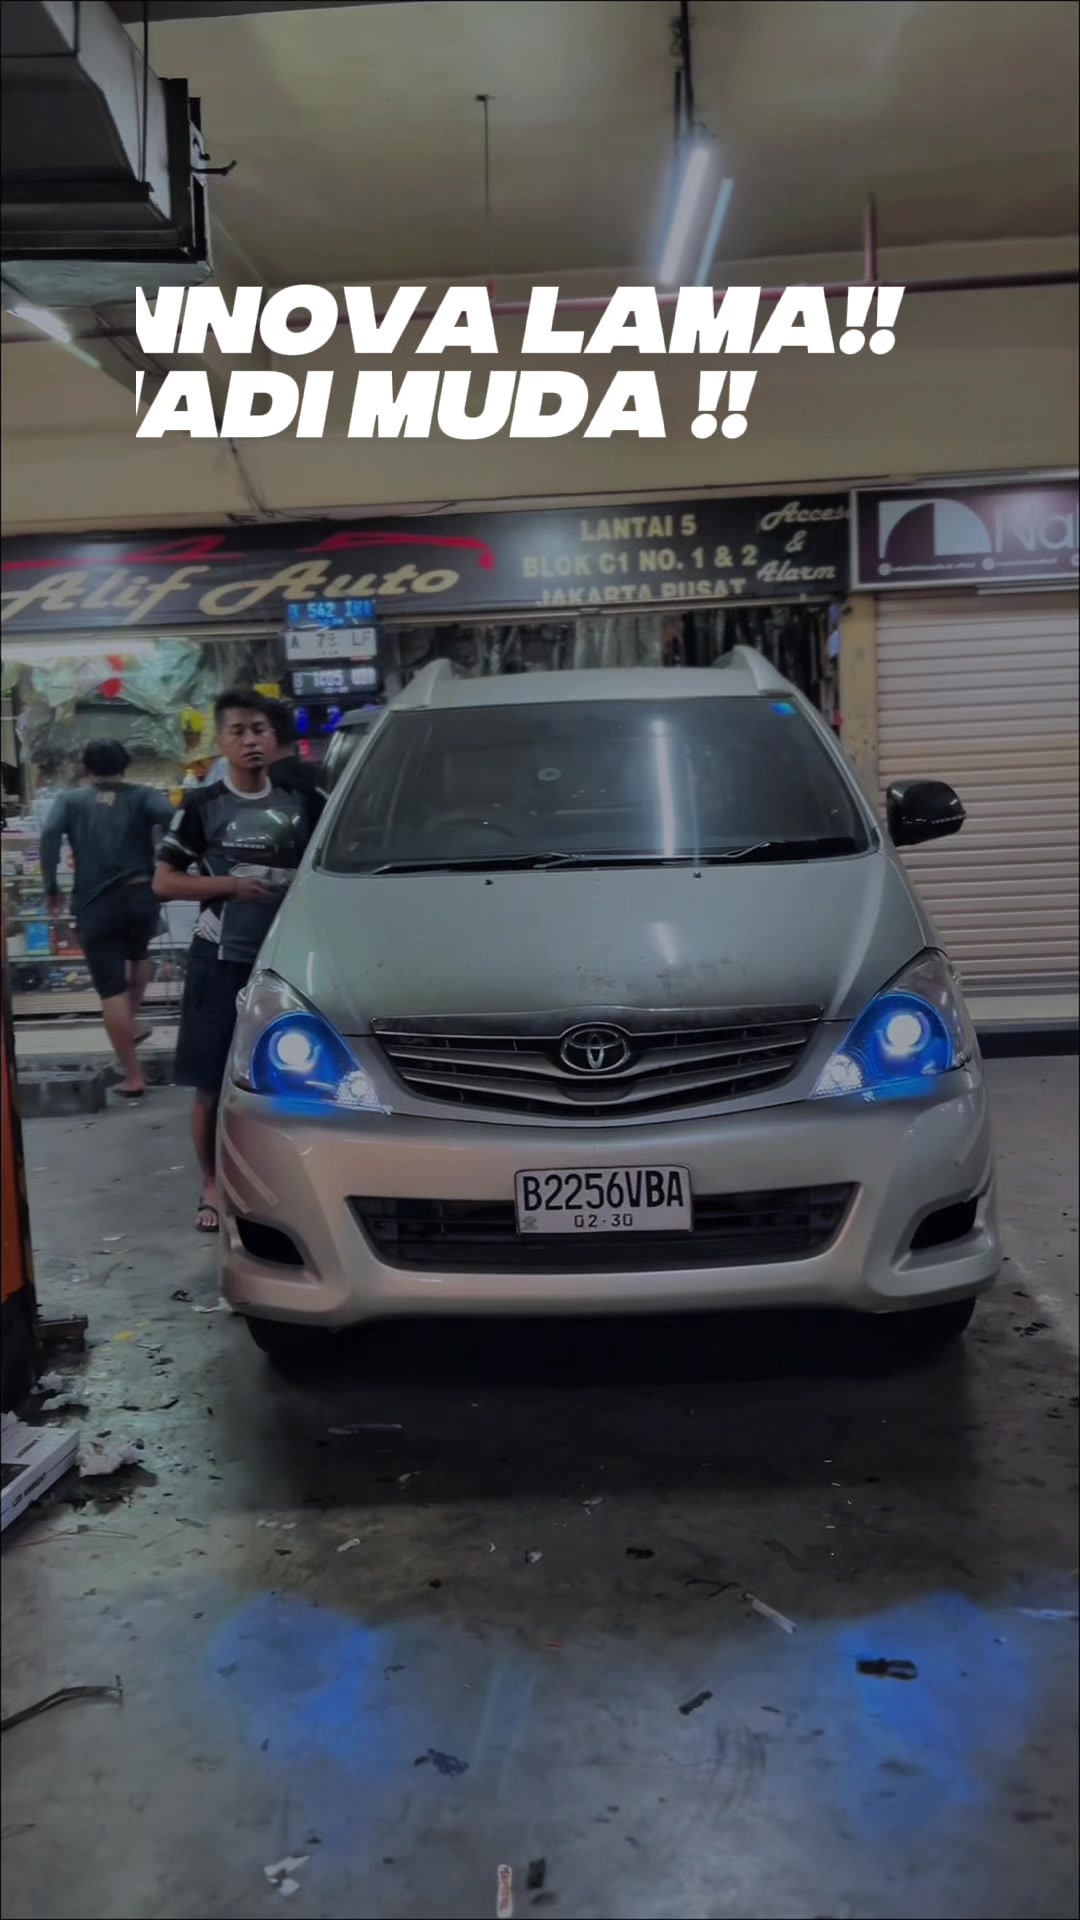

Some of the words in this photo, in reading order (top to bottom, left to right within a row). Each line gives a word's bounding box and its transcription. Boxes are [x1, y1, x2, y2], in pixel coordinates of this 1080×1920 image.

[580, 515, 673, 541] LANTAI
[681, 514, 696, 536] 5
[785, 530, 808, 553] &
[522, 554, 592, 578] BLOK
[600, 552, 629, 574] C1
[639, 548, 684, 571] NO.
[692, 547, 704, 568] 1
[715, 545, 733, 568] &
[742, 544, 758, 566] 2
[757, 559, 837, 583] Alarm
[1, 565, 210, 625] Alif
[198, 559, 461, 616] Auto
[290, 635, 301, 650] A
[522, 1170, 684, 1212] B2256VBA
